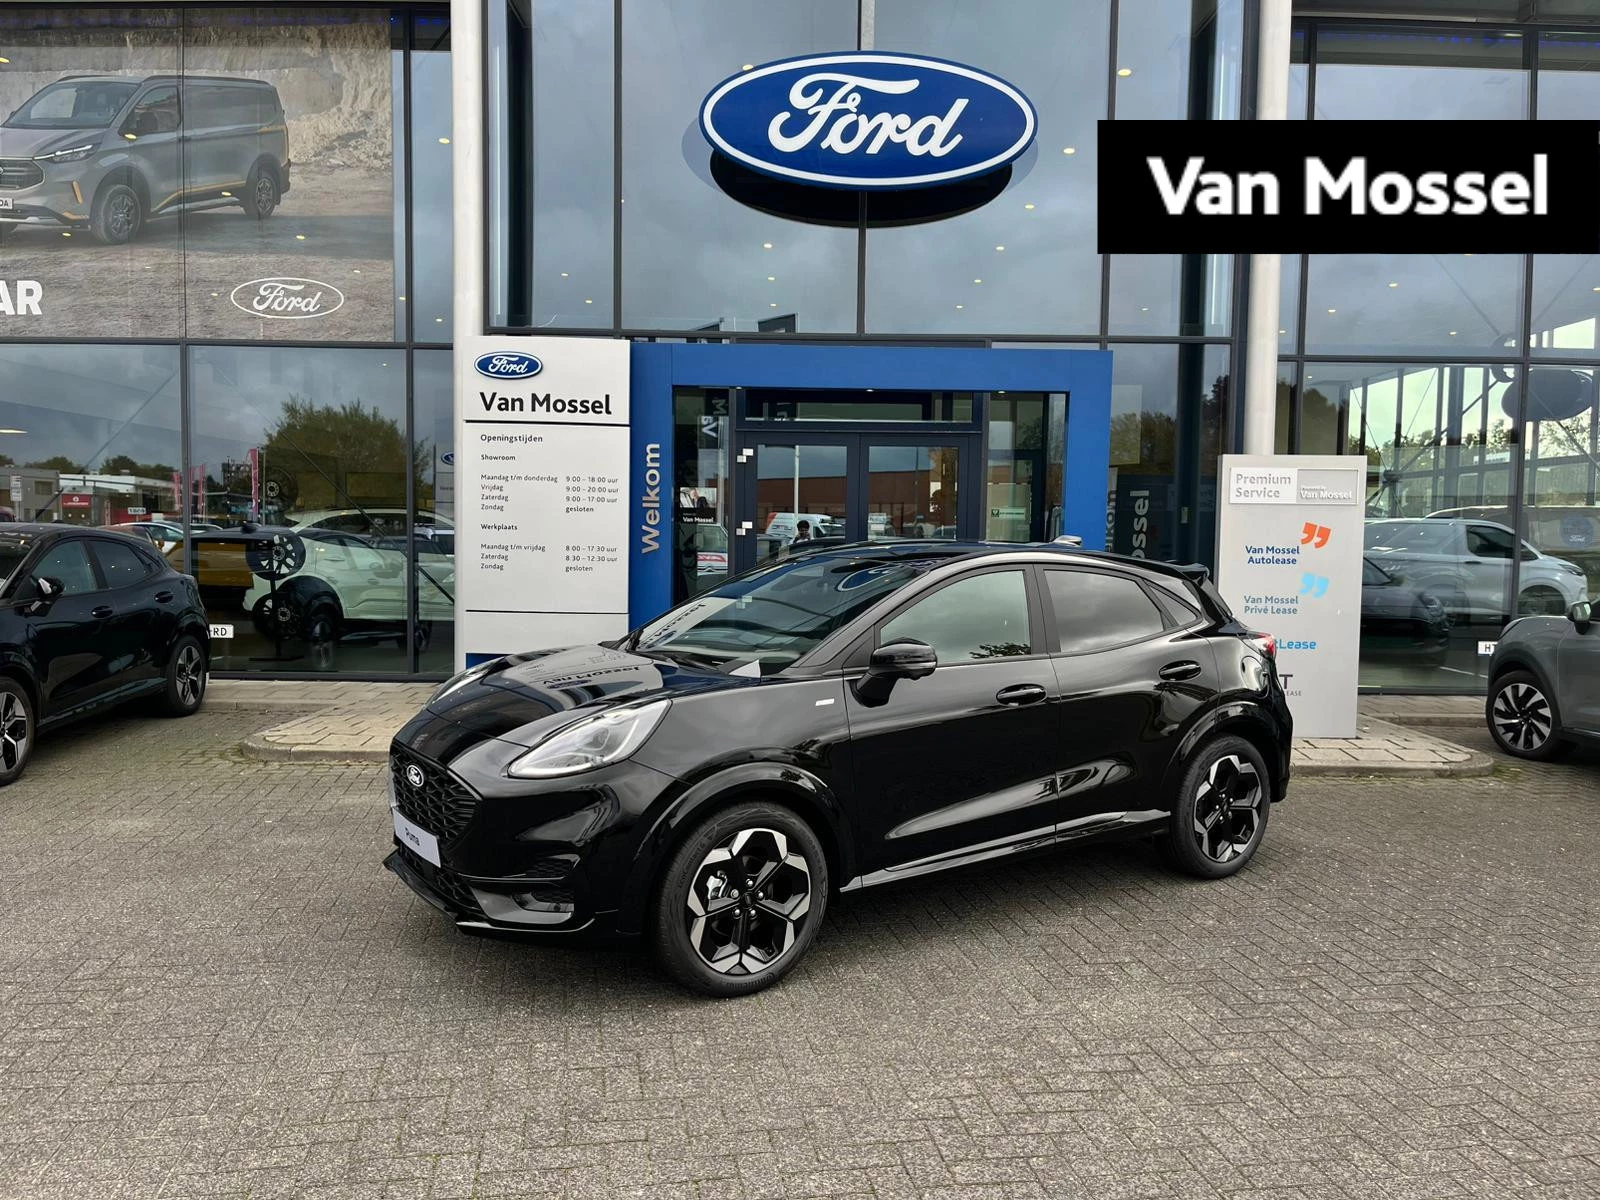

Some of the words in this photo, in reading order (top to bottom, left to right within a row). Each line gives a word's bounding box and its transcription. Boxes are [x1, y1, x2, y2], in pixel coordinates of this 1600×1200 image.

[767, 73, 969, 157] Ford
[253, 282, 322, 312] Ford
[488, 355, 529, 374] Ford
[479, 391, 525, 412] Van
[531, 393, 612, 415] Mossel
[480, 434, 543, 444] Openingstijden
[480, 474, 509, 482] Maandag
[510, 474, 522, 482] t/m
[1235, 474, 1292, 485] Premium
[480, 484, 504, 492] Vrijdag
[1235, 487, 1281, 498] Service
[480, 494, 509, 502] Zaterdag
[641, 443, 660, 554] Welkom
[1300, 490, 1318, 498] Van
[1320, 490, 1352, 499] Mossel
[480, 504, 504, 512] Zondag
[480, 523, 518, 531] Werkplaats
[480, 543, 509, 551] Maandag
[523, 544, 546, 552] vrijdag
[1245, 545, 1263, 554] Van
[1265, 546, 1300, 554] Mossel
[480, 553, 509, 561] Zaterdag
[1247, 556, 1297, 564] Autolease
[480, 563, 504, 571] Zondag
[1244, 596, 1262, 604] Van
[1265, 596, 1299, 604] Mossel
[1244, 605, 1269, 614] Privé
[1271, 606, 1298, 614] Lease
[210, 627, 227, 636] RD
